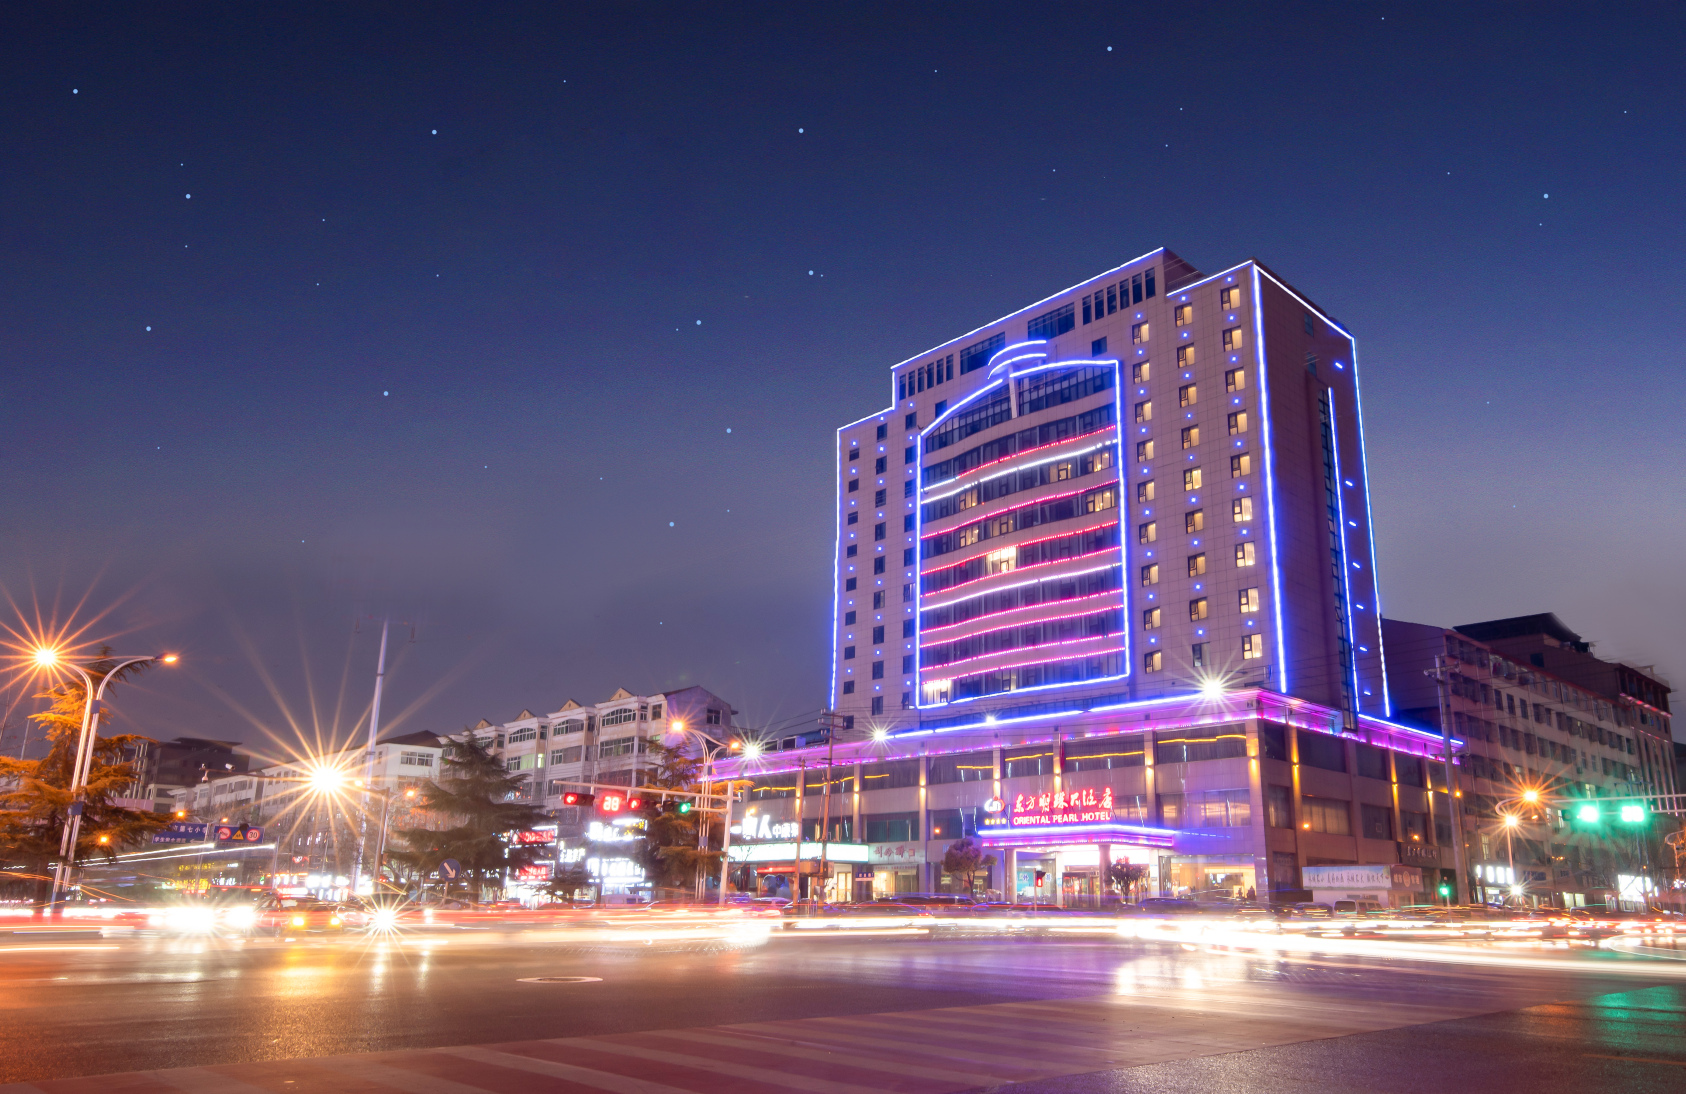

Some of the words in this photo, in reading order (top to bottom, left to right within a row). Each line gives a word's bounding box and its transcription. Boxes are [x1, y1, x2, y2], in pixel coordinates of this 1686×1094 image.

[1013, 815, 1050, 826] ORIENTAL
[1052, 813, 1079, 823] PEARL
[1082, 811, 1111, 821] HOTEL
[248, 831, 258, 839] 30
